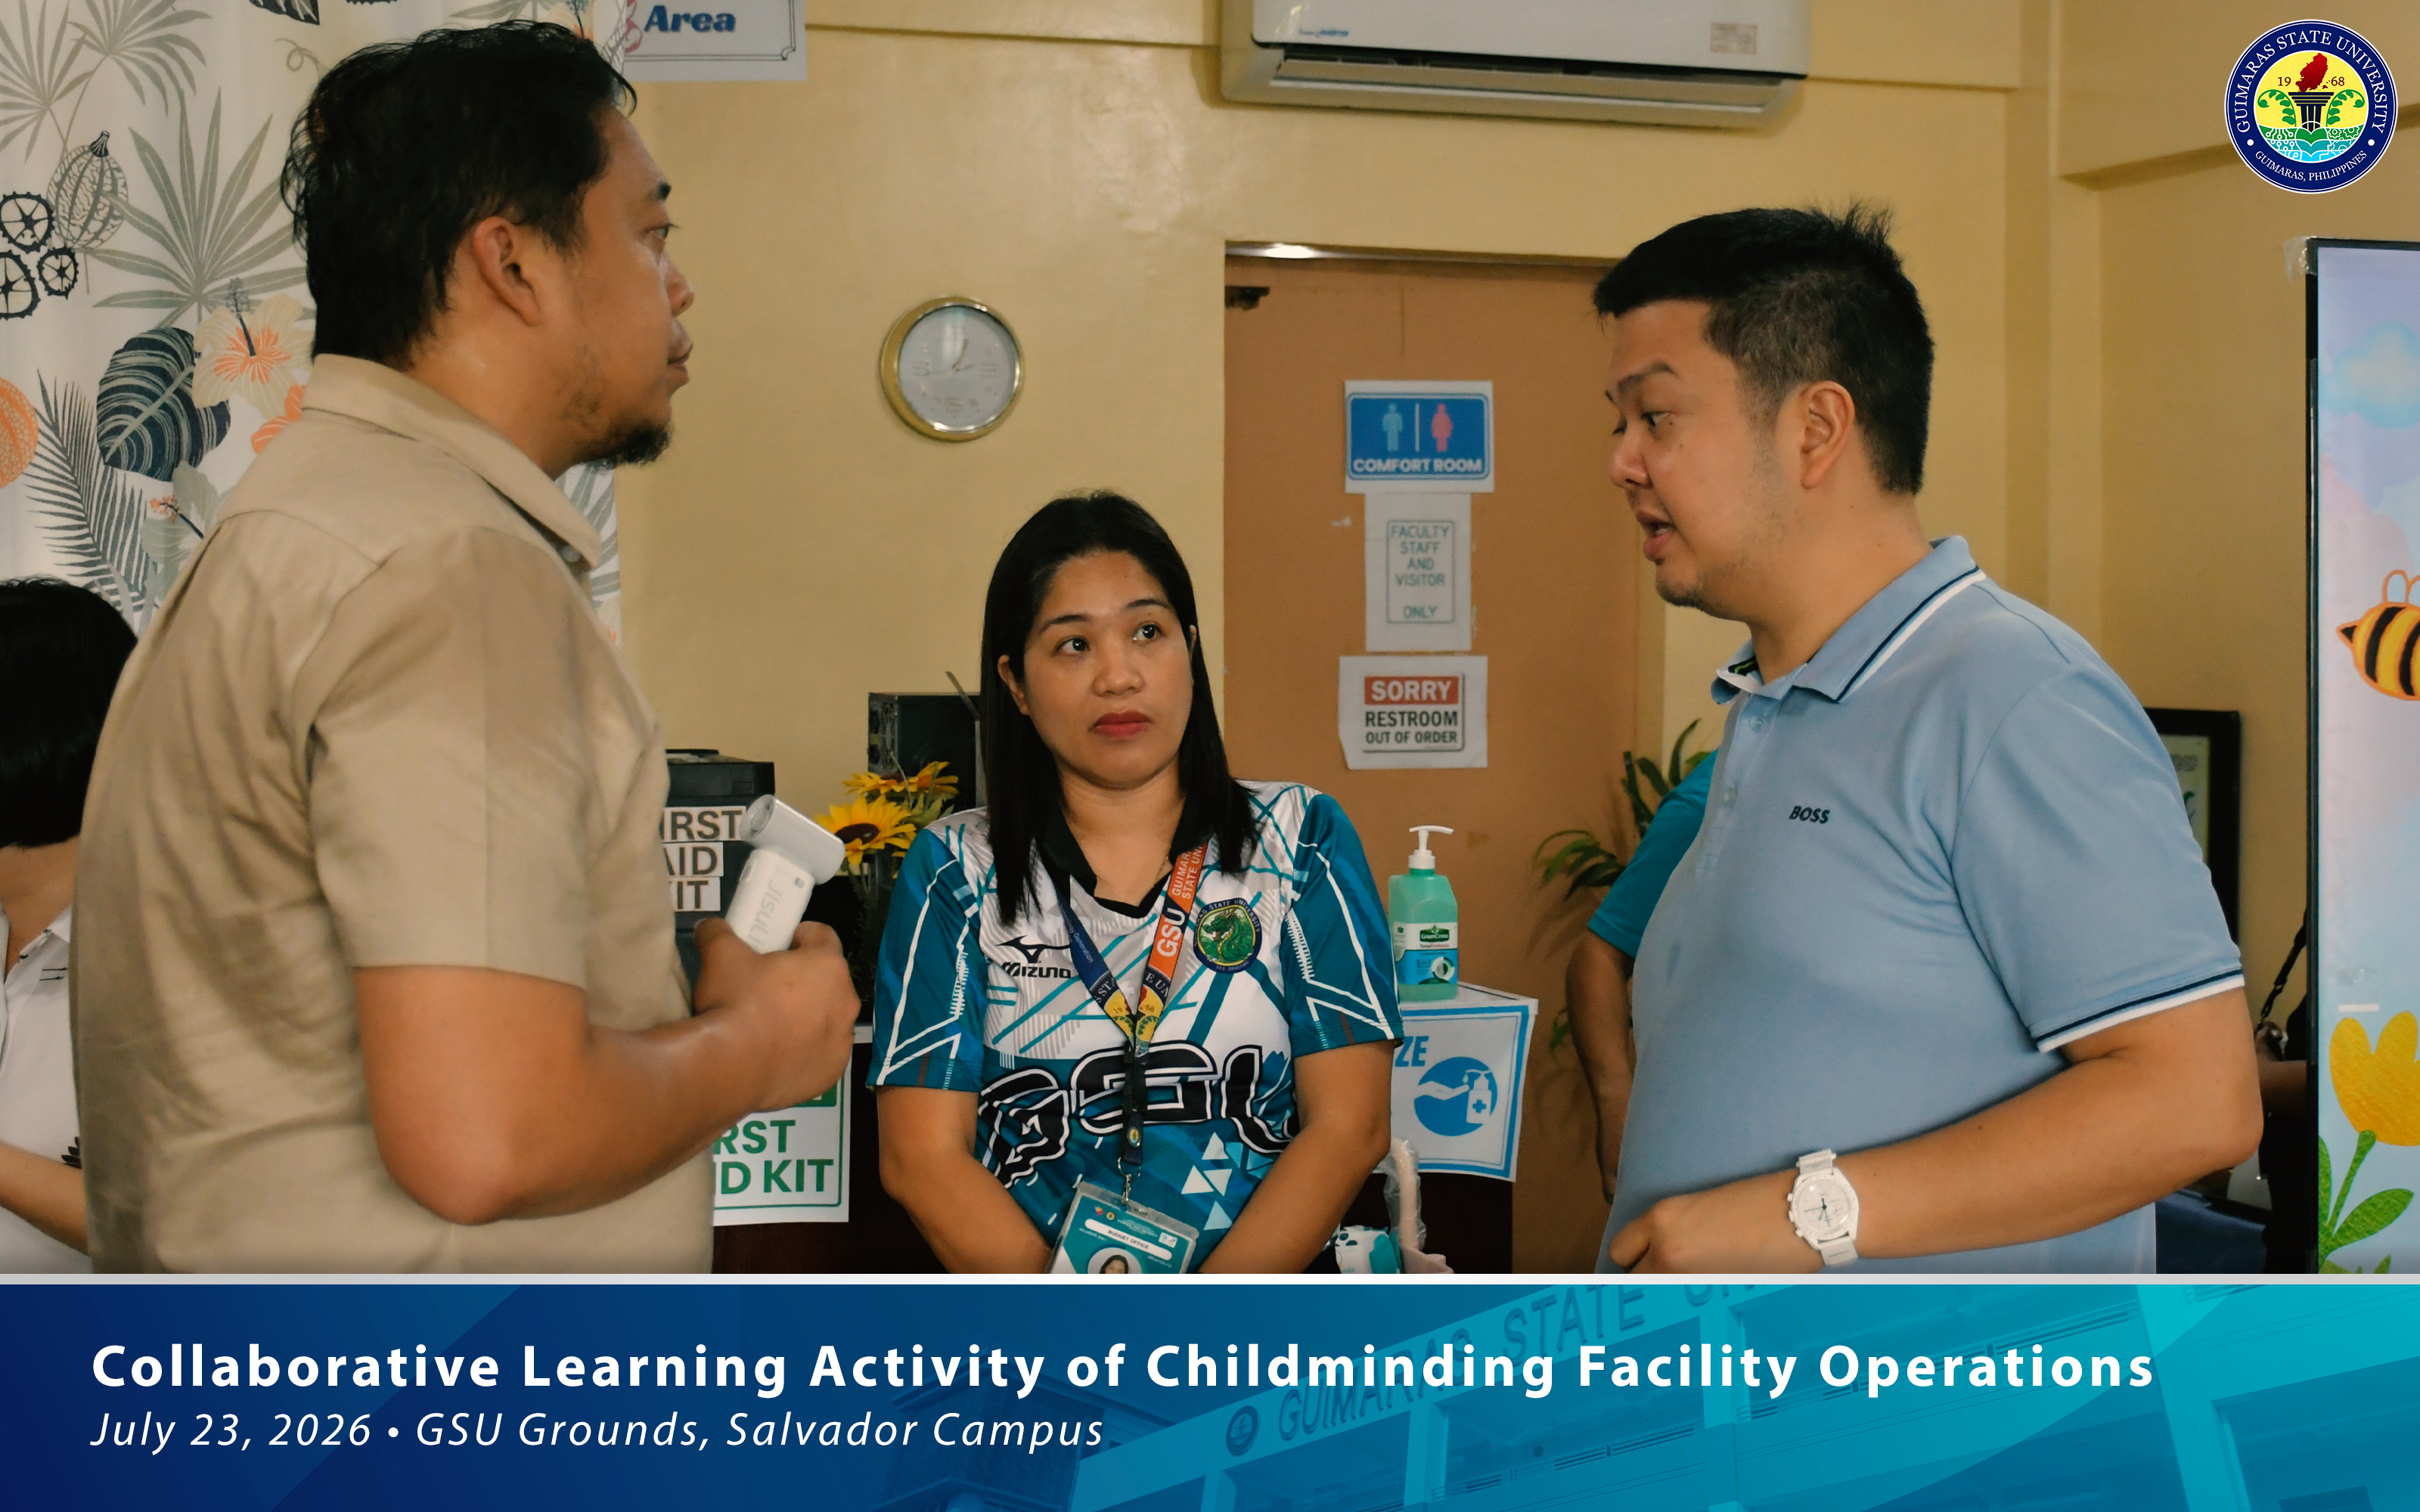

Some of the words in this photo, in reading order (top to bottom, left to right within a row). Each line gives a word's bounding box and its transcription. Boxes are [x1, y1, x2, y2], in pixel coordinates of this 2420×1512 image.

[644, 5, 736, 33] Area
[1353, 458, 1431, 472] COMFORT
[1434, 458, 1482, 472] ROOM
[1390, 525, 1450, 538] FACULTY
[1401, 541, 1440, 554] STAFF
[1407, 558, 1434, 570] AND
[1395, 573, 1445, 586] VISITOR
[1403, 606, 1437, 618] ONLY
[1372, 680, 1452, 702] SORRY
[1365, 711, 1458, 727] RESTROOM
[1366, 731, 1390, 744] OUT
[1395, 731, 1410, 743] OF
[1414, 730, 1457, 743] ORDER
[1789, 806, 1830, 824] BOSS
[1181, 866, 1198, 900] STATE
[1157, 908, 1186, 957] GSU
[1074, 932, 1094, 963] Generation
[763, 1158, 834, 1193] KIT
[1108, 1229, 1130, 1243] BUDGET
[1130, 1237, 1150, 1250] OFFICE
